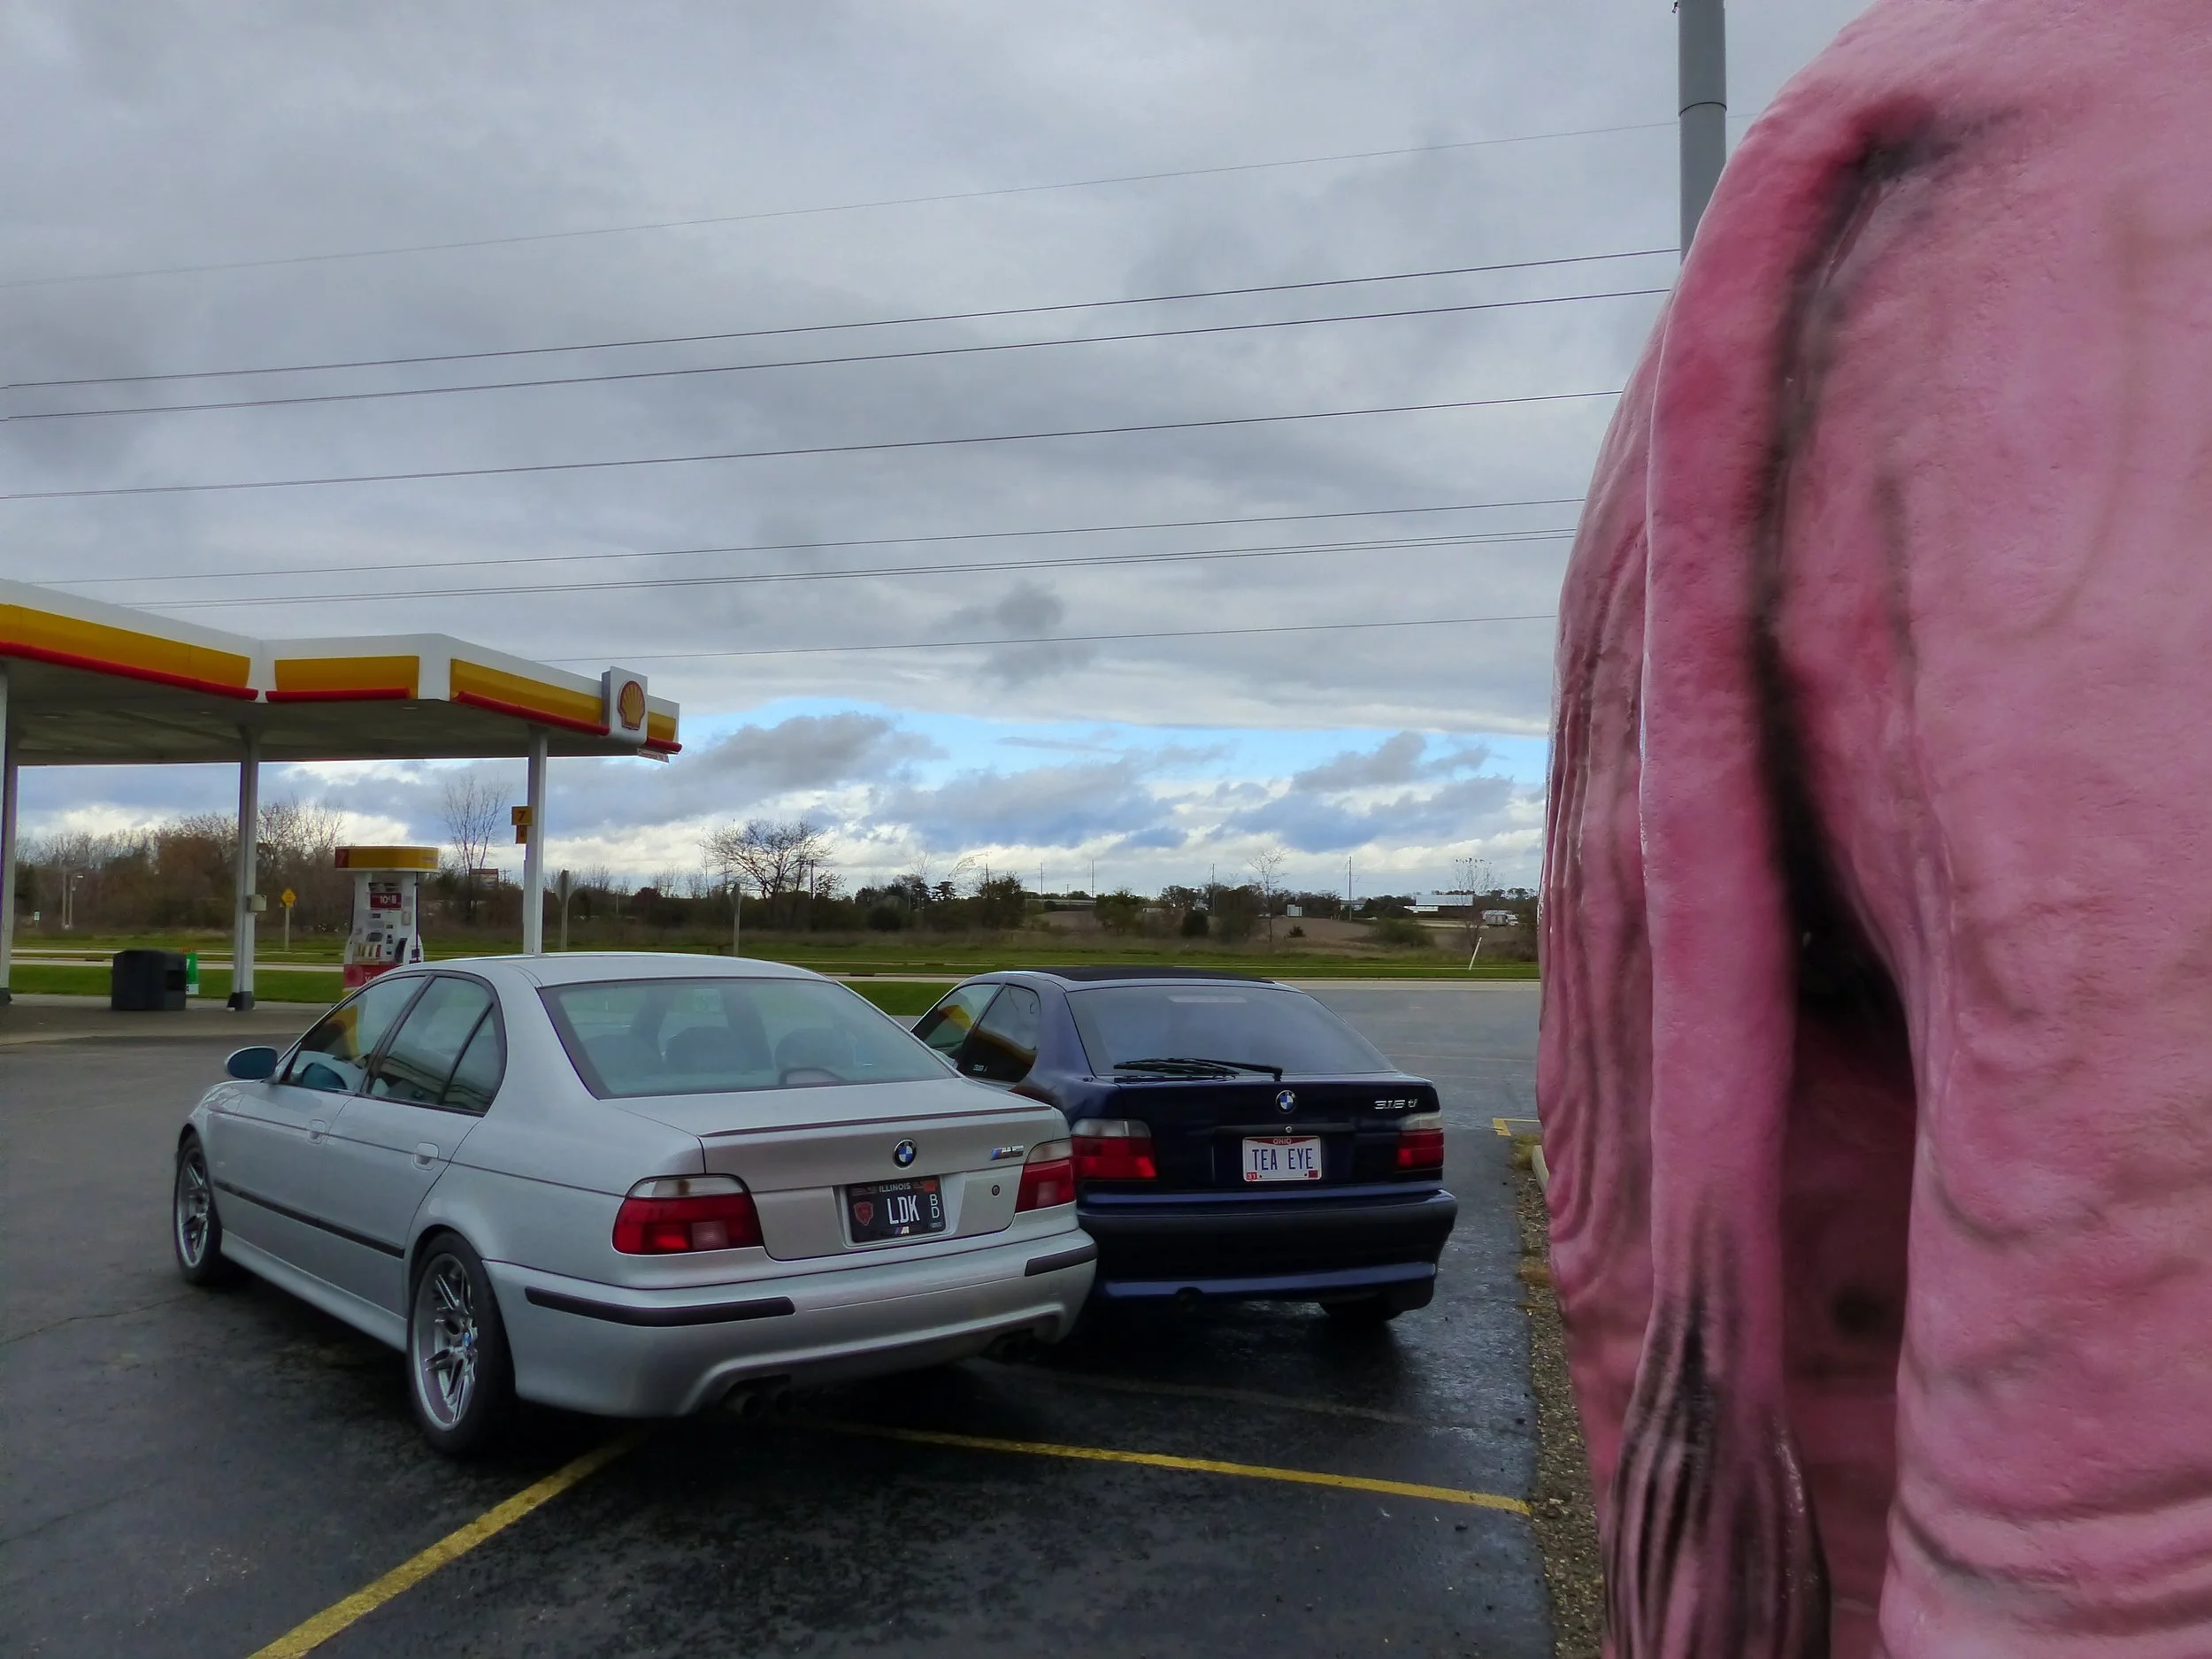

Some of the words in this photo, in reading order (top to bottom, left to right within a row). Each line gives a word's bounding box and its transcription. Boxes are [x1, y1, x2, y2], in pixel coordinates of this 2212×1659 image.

[518, 810, 526, 822] 7
[1252, 1148, 1278, 1171] TEA
[1287, 1148, 1313, 1170] EYE
[879, 1182, 911, 1193] ILLINOIS
[887, 1194, 920, 1225] LDK
